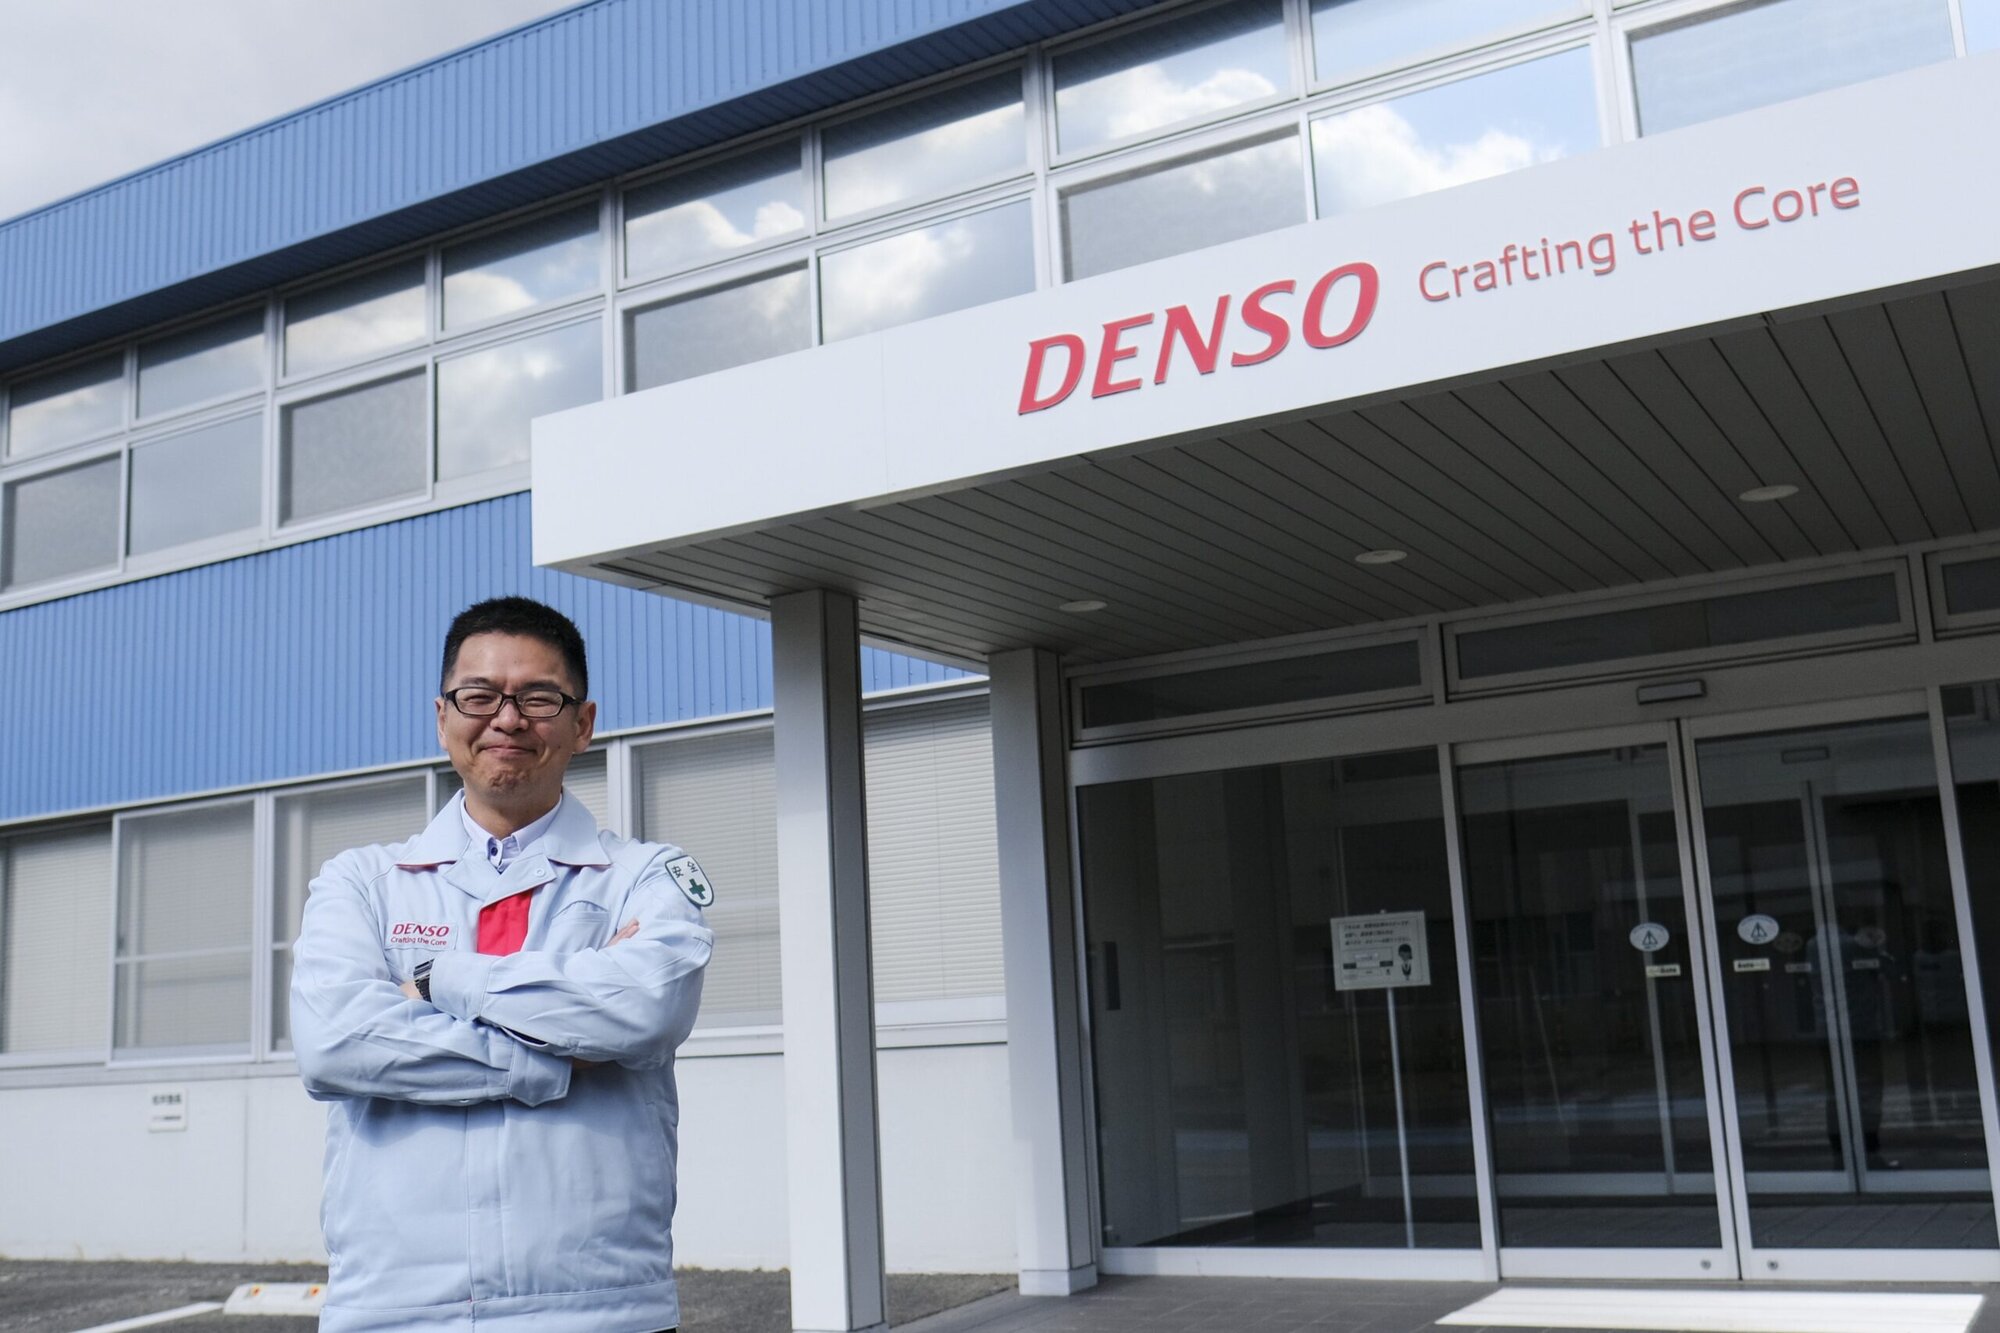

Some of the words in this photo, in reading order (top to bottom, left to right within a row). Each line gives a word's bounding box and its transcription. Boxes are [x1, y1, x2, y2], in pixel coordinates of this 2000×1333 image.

[1418, 231, 1617, 302] Crafting
[1629, 209, 1717, 254] the
[1732, 176, 1861, 230] Core
[1017, 261, 1380, 414] DENSO
[671, 861, 699, 878] 安全
[392, 923, 450, 937] DENSO
[390, 936, 417, 944] Crafting
[417, 937, 430, 945] the
